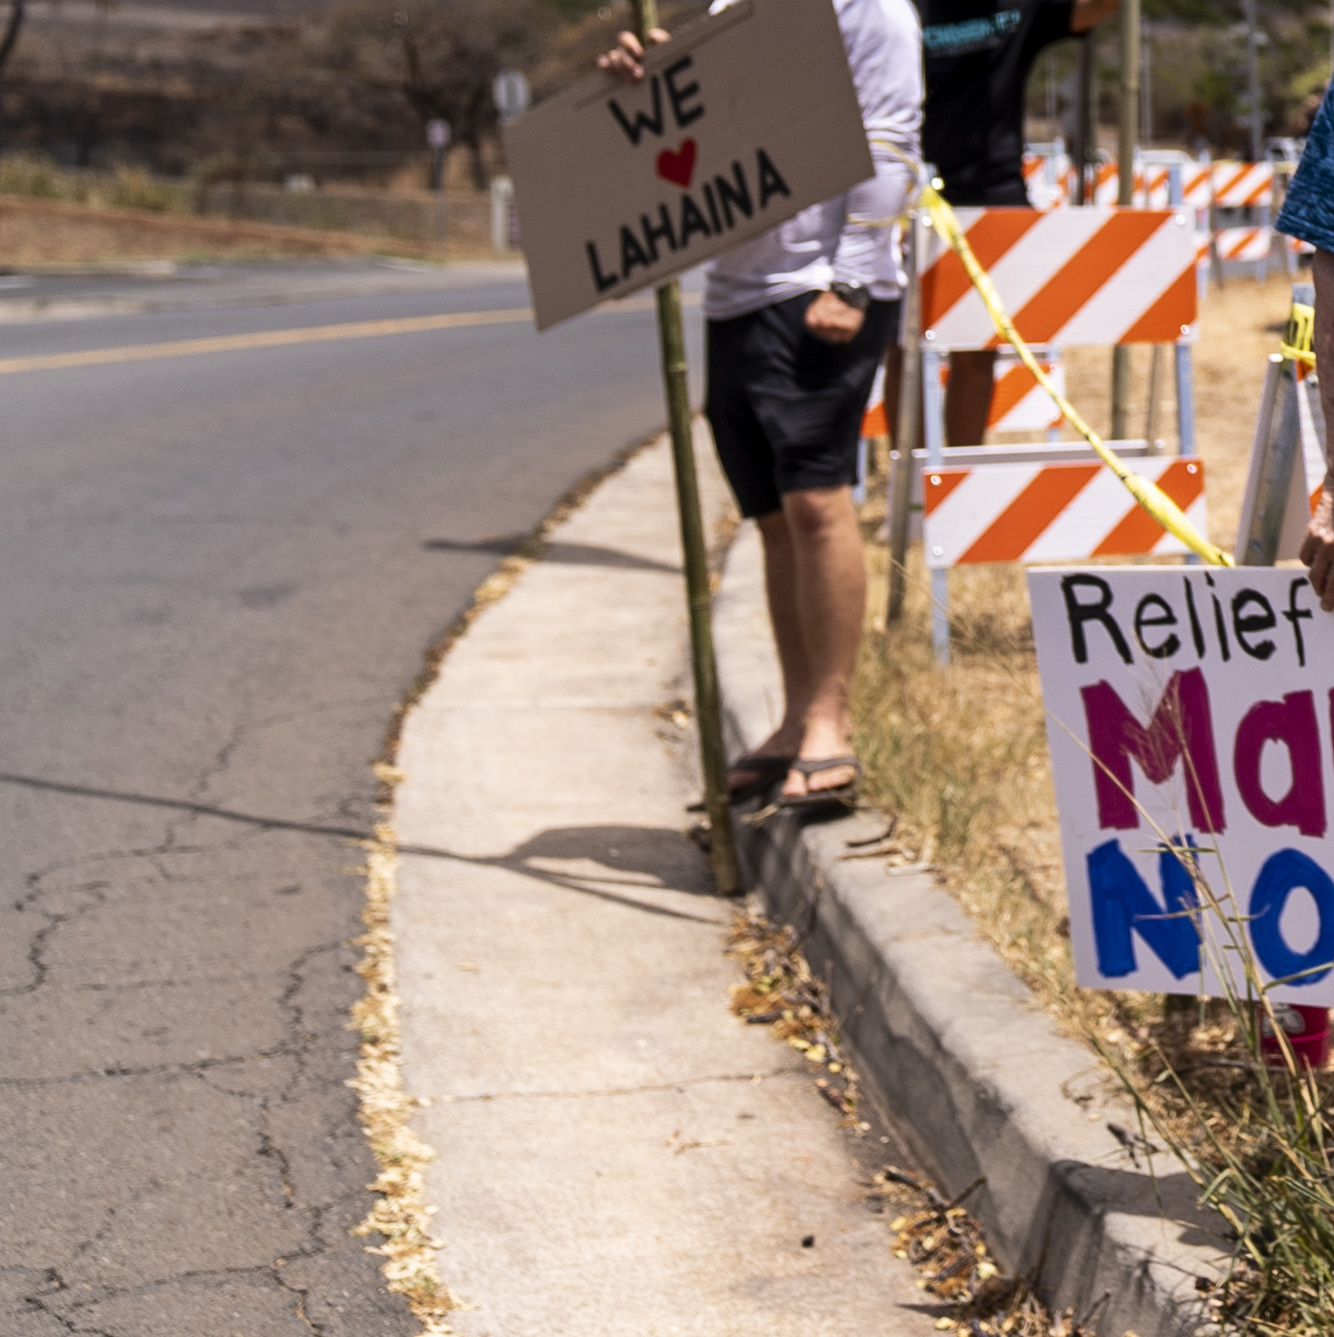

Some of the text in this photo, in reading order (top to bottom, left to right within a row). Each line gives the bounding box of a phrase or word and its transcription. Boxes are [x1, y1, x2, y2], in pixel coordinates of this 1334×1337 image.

[607, 54, 706, 147] WE
[583, 147, 792, 293] LAHAINA
[1060, 571, 1313, 668] Relief
